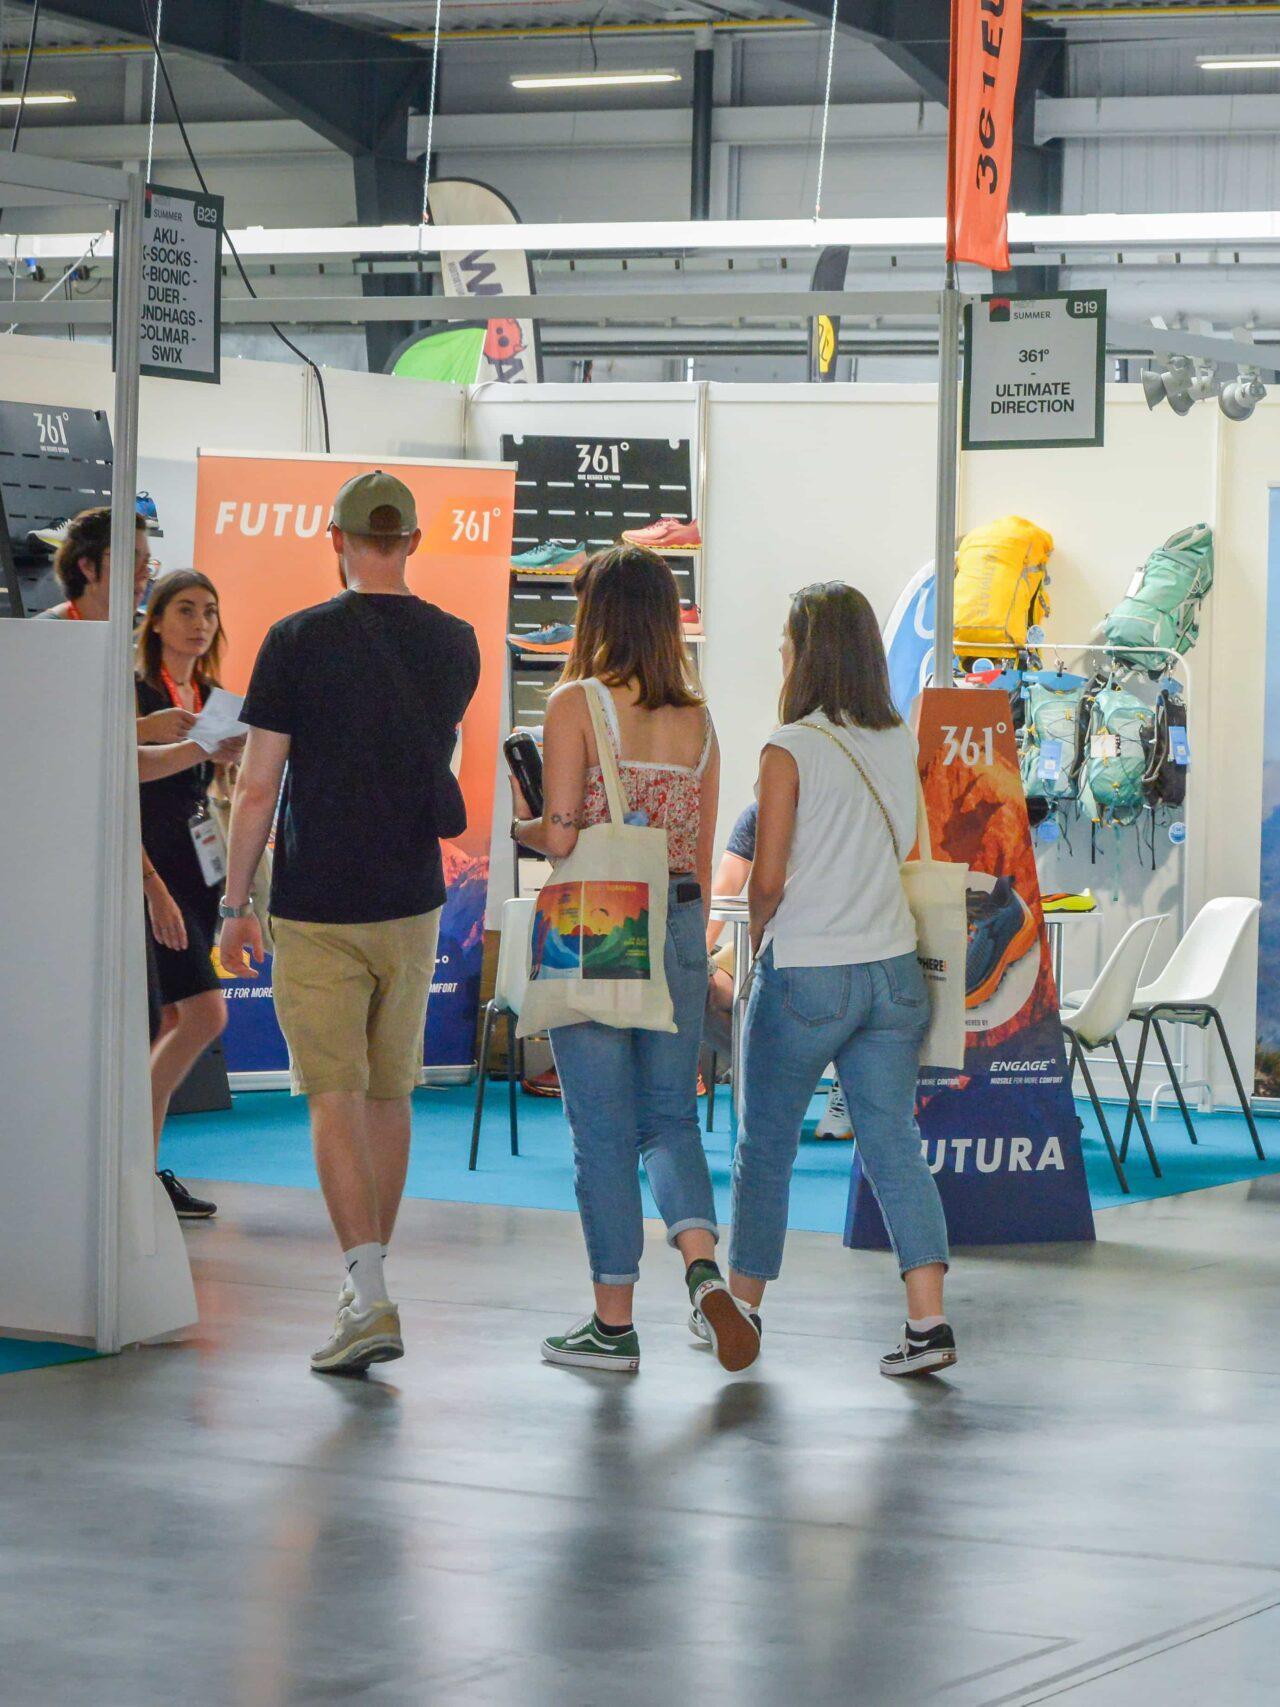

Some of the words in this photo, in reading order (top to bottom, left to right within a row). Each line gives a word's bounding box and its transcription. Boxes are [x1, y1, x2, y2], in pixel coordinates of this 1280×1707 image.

[197, 207, 217, 223] B29
[153, 227, 178, 245] AKU
[148, 285, 180, 305] DUER
[141, 305, 196, 325] UNDHAGS
[1013, 311, 1051, 320] SUMMER
[1074, 301, 1098, 314] B19
[152, 345, 182, 363] SWIX
[995, 382, 1071, 397] ULTIMATE
[990, 399, 1075, 415] DIRECTION
[575, 441, 630, 473] 361°
[215, 501, 333, 538] FUTU
[940, 722, 1007, 767] 361°
[233, 987, 250, 999] FOR
[250, 987, 273, 998] MORE
[1039, 1076, 1064, 1084] COMFORT
[920, 1136, 1065, 1175] UTURA
